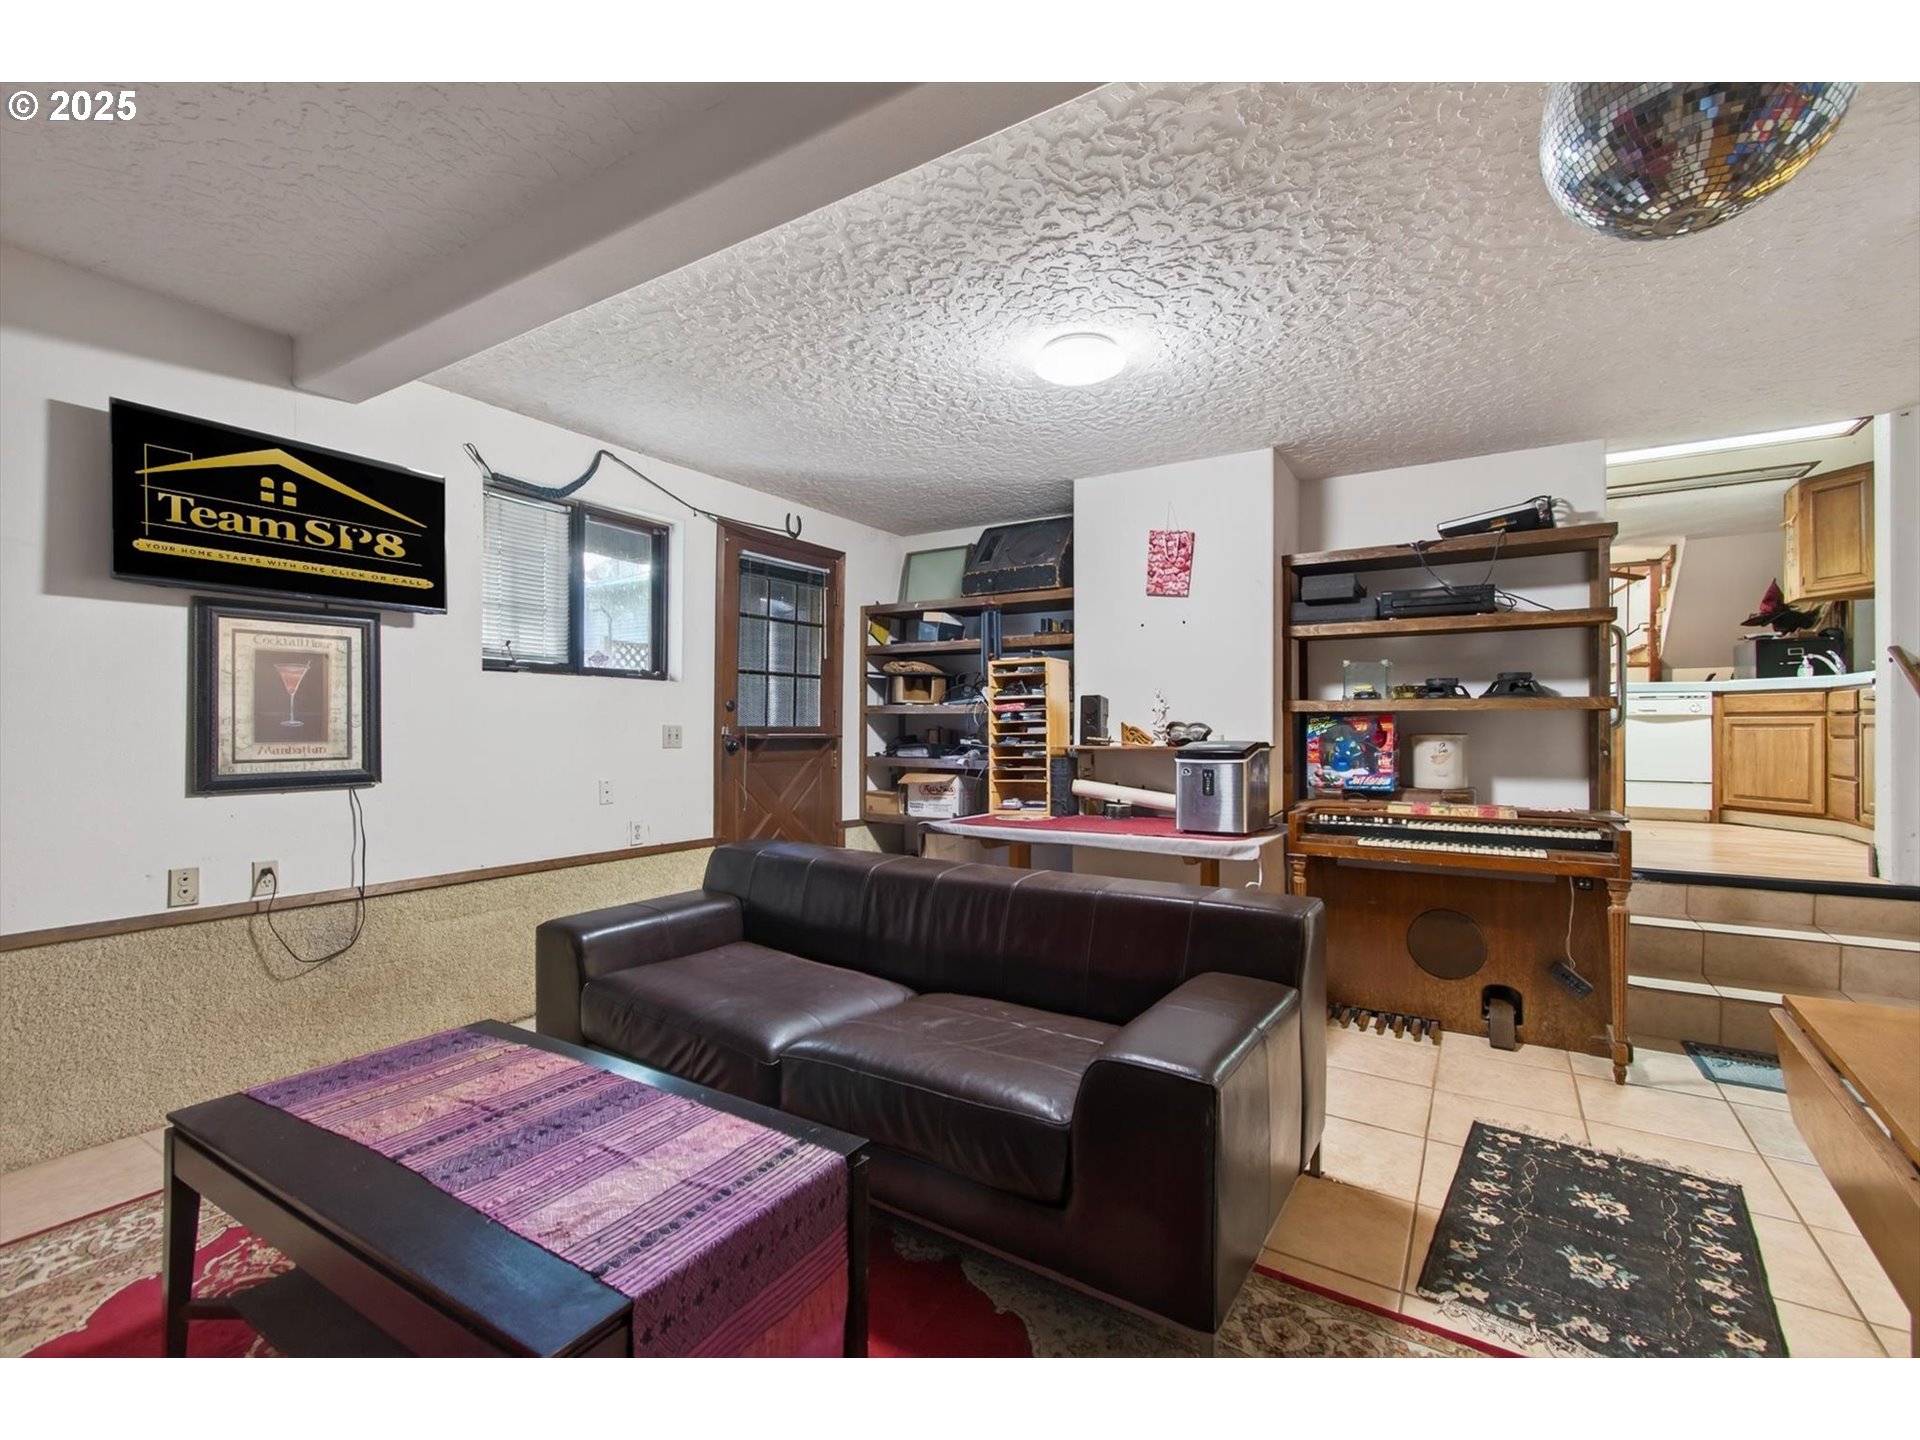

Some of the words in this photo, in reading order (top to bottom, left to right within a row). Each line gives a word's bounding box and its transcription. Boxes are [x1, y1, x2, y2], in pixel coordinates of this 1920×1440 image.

[145, 543, 176, 552] YOUR
[181, 548, 213, 557] HOME
[218, 553, 261, 564] STARTS
[267, 559, 297, 569] WITH
[302, 564, 325, 573] ONE
[331, 569, 365, 579] CLICK
[393, 578, 422, 587] CALL
[252, 633, 302, 648] Cocktail
